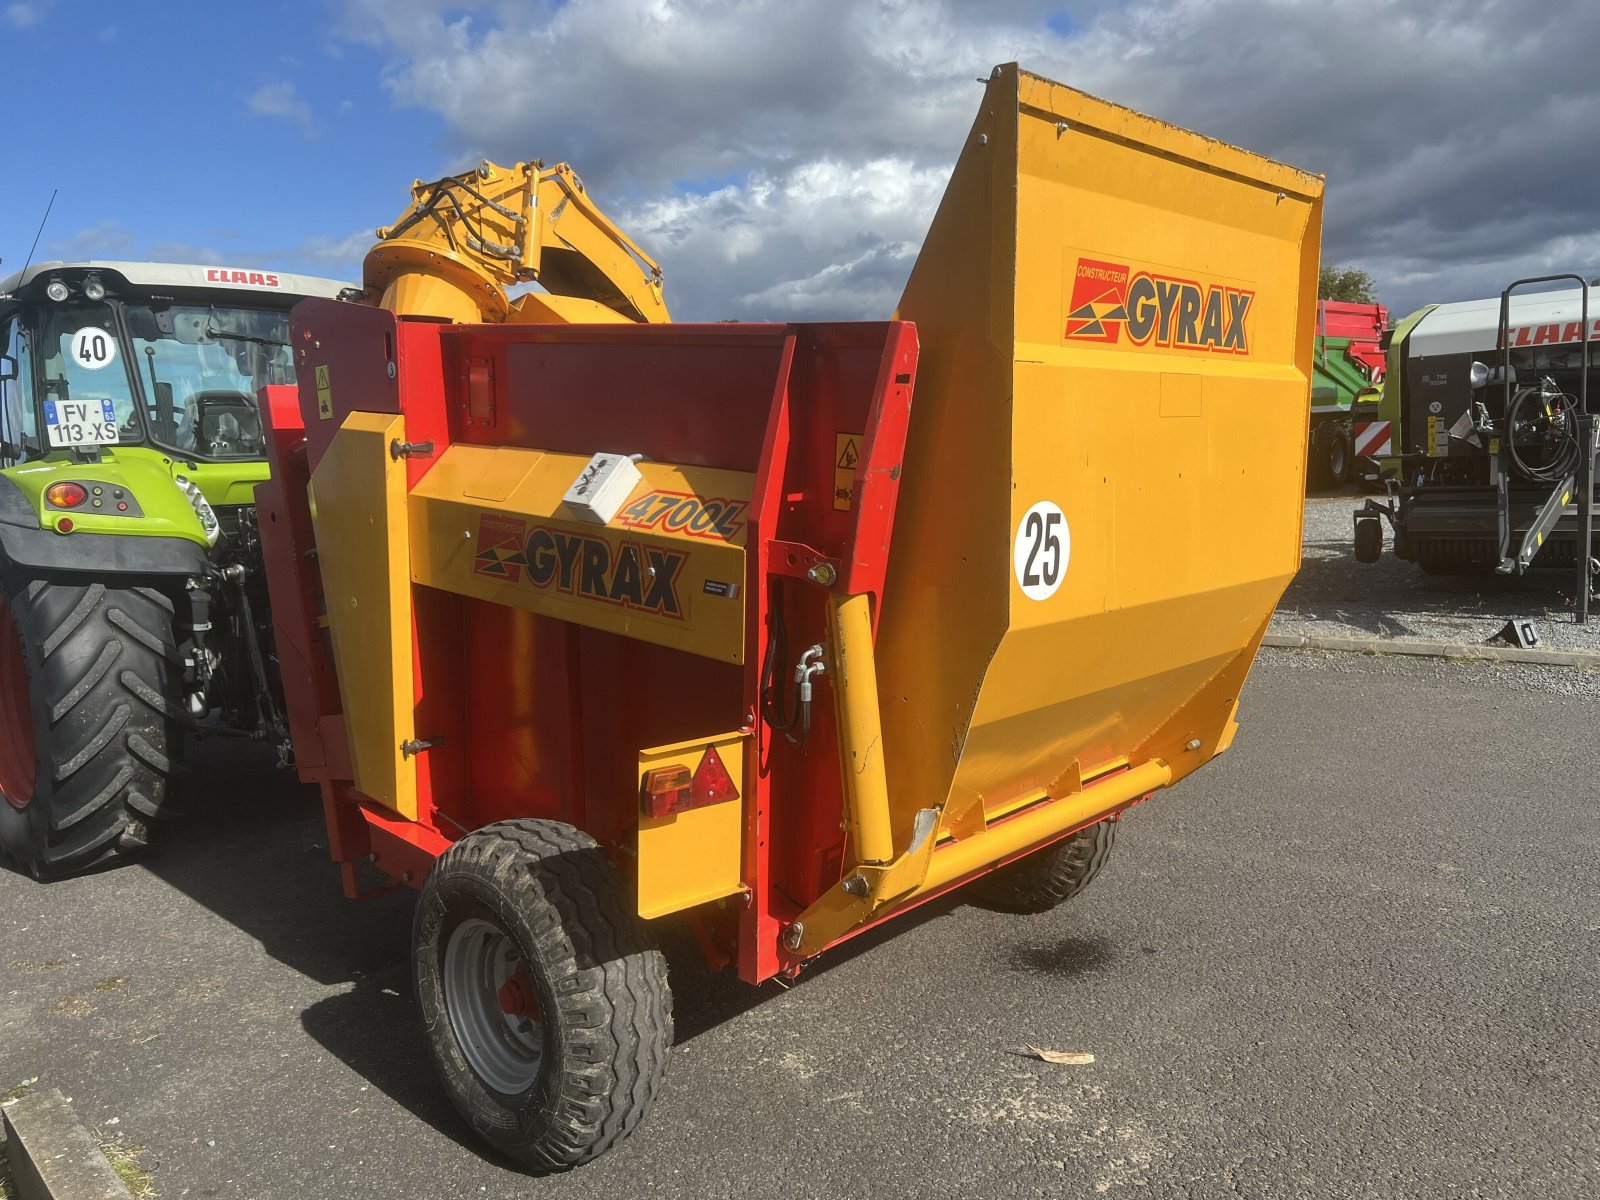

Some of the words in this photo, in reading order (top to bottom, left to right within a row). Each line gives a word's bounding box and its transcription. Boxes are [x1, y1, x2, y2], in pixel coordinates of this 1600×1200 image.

[207, 269, 279, 287] CLAAS
[1077, 265, 1127, 284] CONSTRUCTEUR
[1125, 274, 1253, 352] GYRAX
[79, 334, 107, 362] 40
[104, 412, 115, 421] 63
[480, 518, 525, 535] CONSTRUCTEUR
[621, 491, 743, 539] 4700L
[1022, 511, 1061, 587] 25
[525, 526, 686, 618] GYRAX
